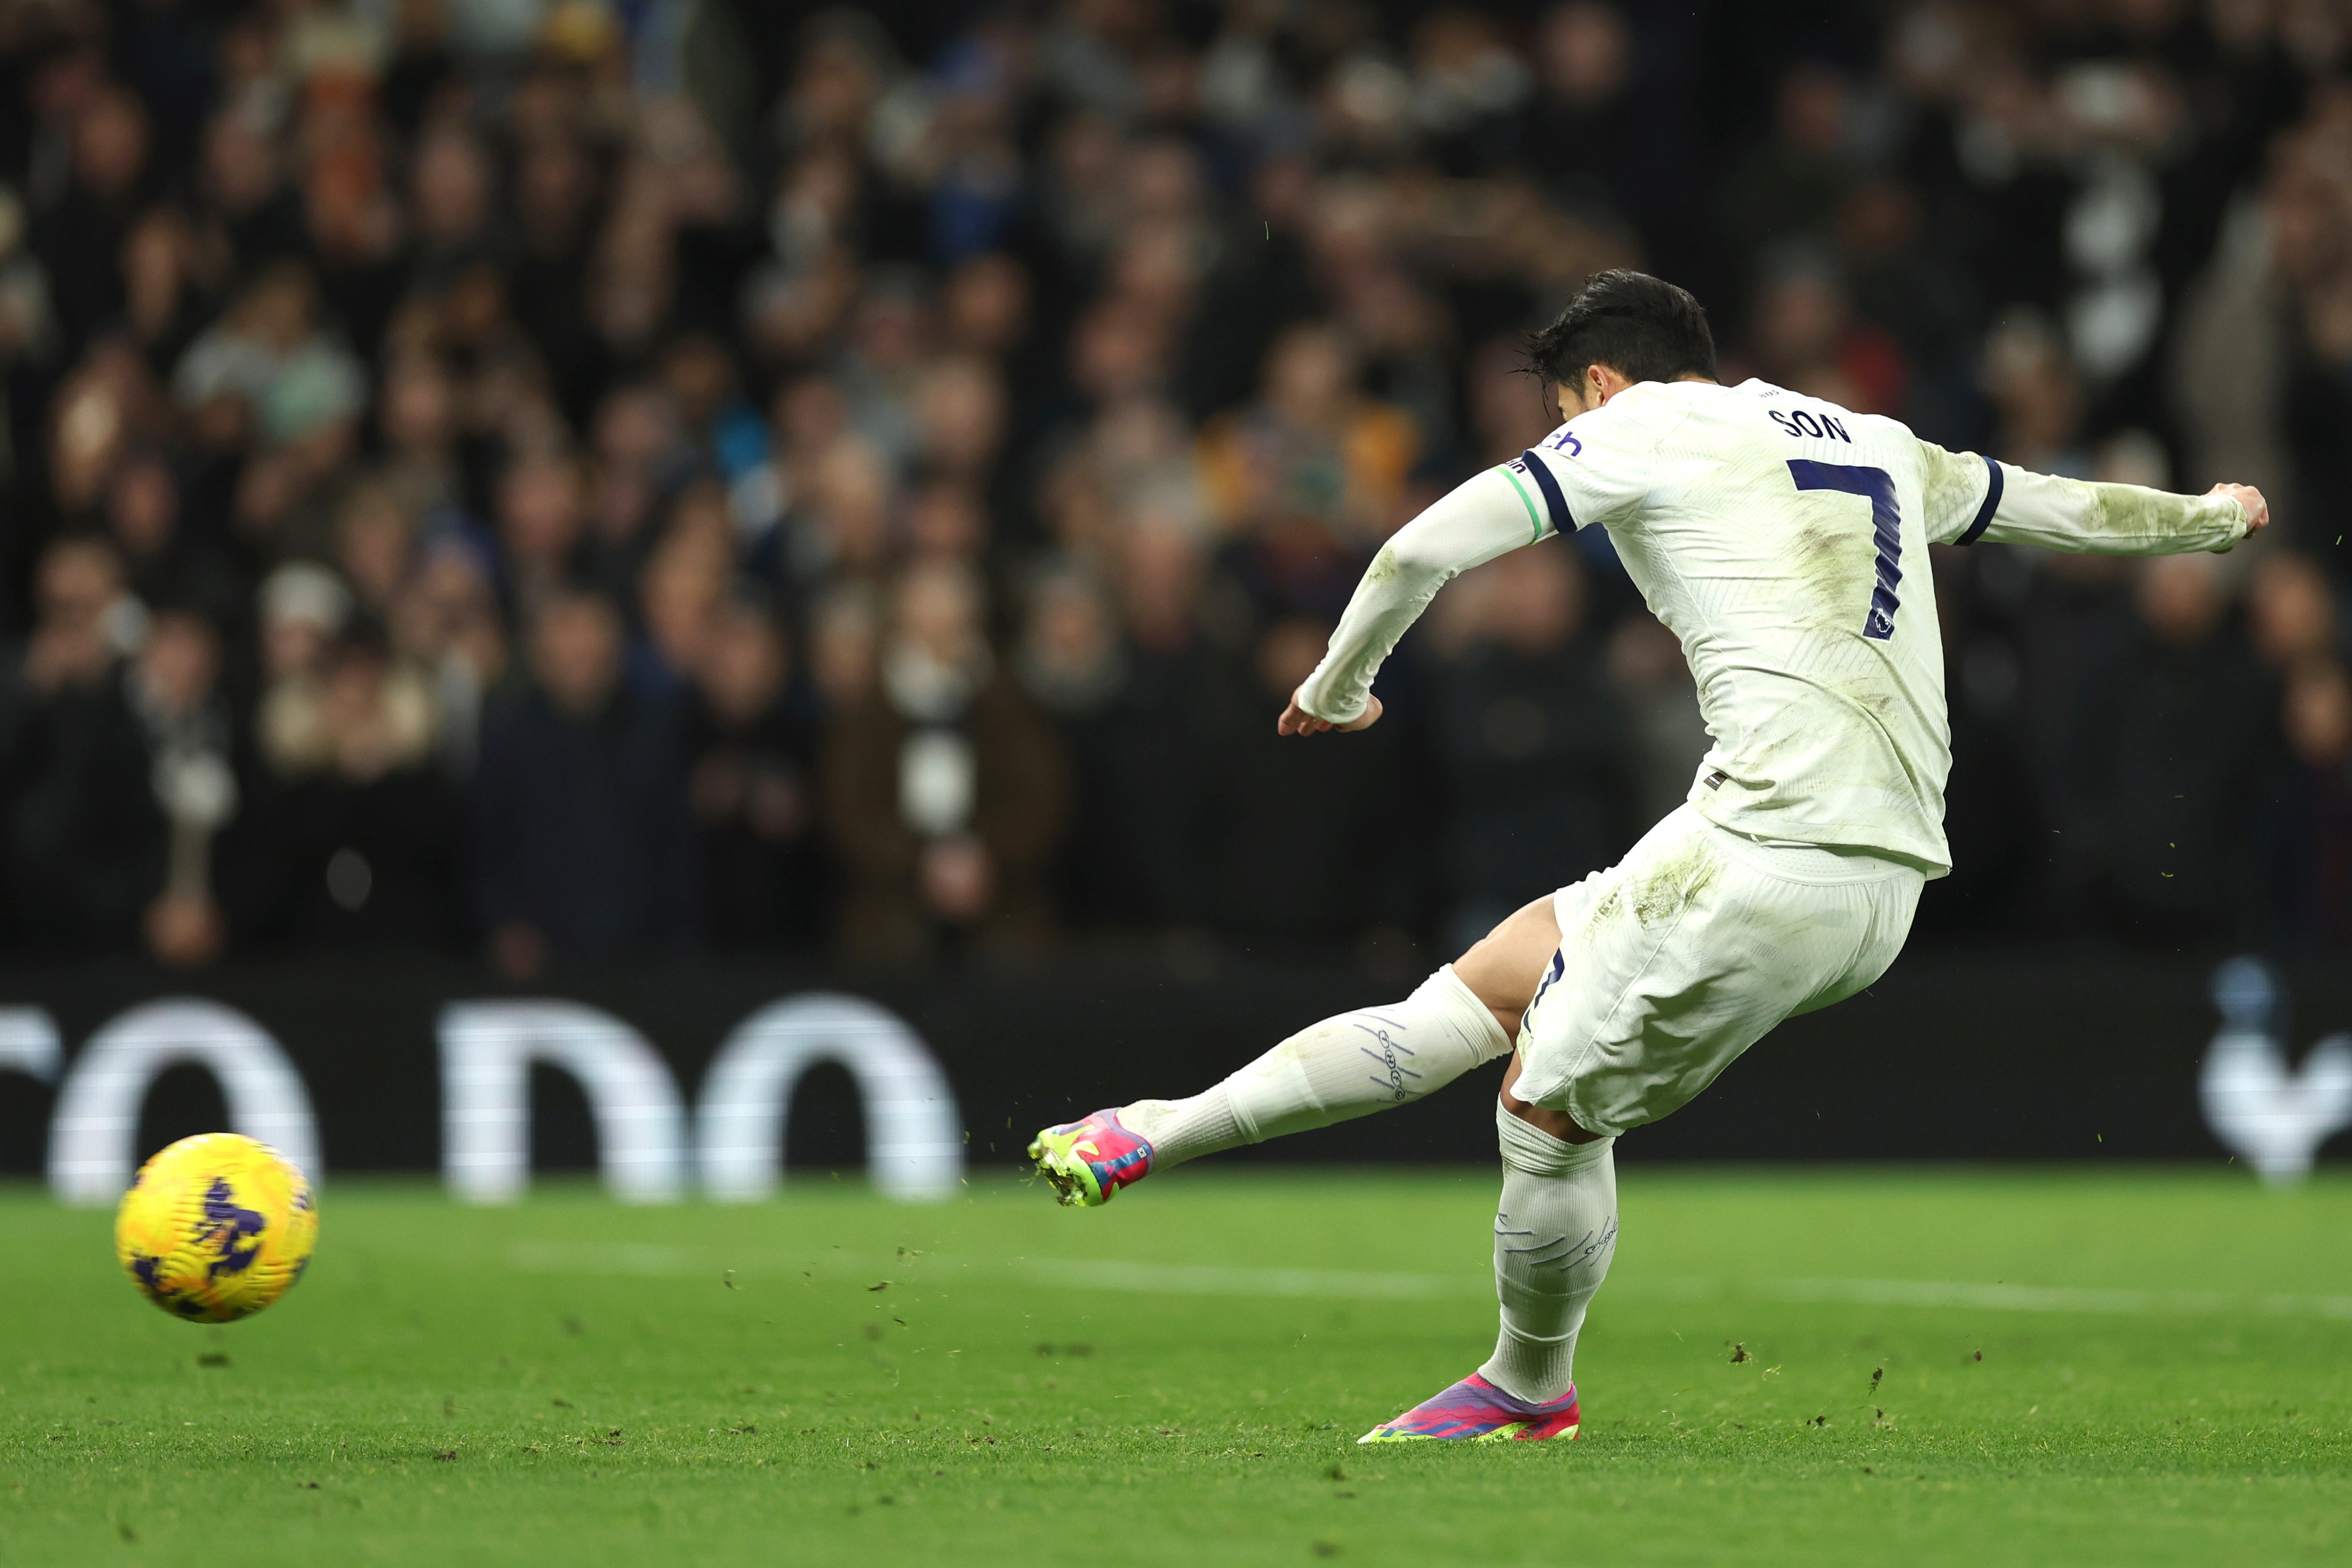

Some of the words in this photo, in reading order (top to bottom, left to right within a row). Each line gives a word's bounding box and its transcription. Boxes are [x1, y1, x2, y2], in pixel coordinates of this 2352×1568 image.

[1759, 390, 1779, 398] 805
[1769, 410, 1852, 444] SON
[1786, 459, 1903, 641] 7
[0, 1000, 321, 1207] O
